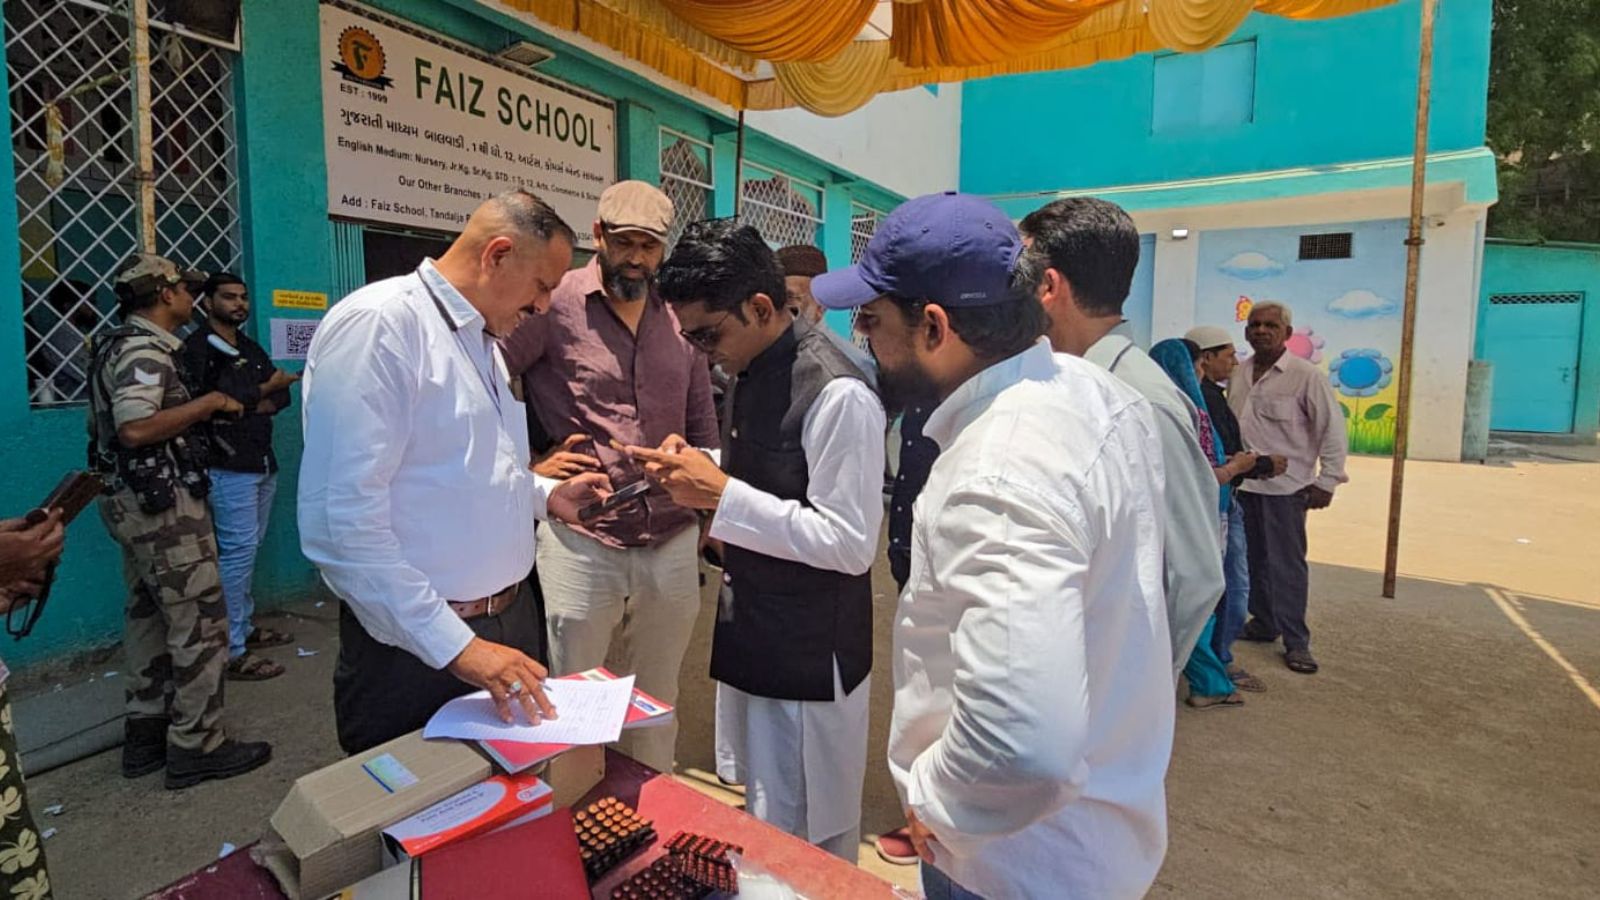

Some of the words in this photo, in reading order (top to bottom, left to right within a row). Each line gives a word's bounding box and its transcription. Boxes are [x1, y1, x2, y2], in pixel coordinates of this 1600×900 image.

[340, 83, 358, 96] EST
[367, 90, 388, 104] 1999
[415, 57, 486, 118] FAIZ
[497, 86, 601, 153] SCHOOL
[340, 108, 383, 129] ગુજરાતી
[386, 119, 418, 138] માધ્યમ
[424, 129, 465, 149] બાલવાડી
[337, 136, 373, 153] English
[376, 145, 413, 161] Medium:
[415, 153, 448, 170] Nursery,
[398, 174, 415, 187] Our
[417, 178, 442, 192] Other
[444, 183, 481, 199] Branches
[341, 194, 362, 207] Add
[371, 199, 391, 212] Faiz
[393, 202, 428, 217] School,
[430, 208, 464, 224] Tandalja
